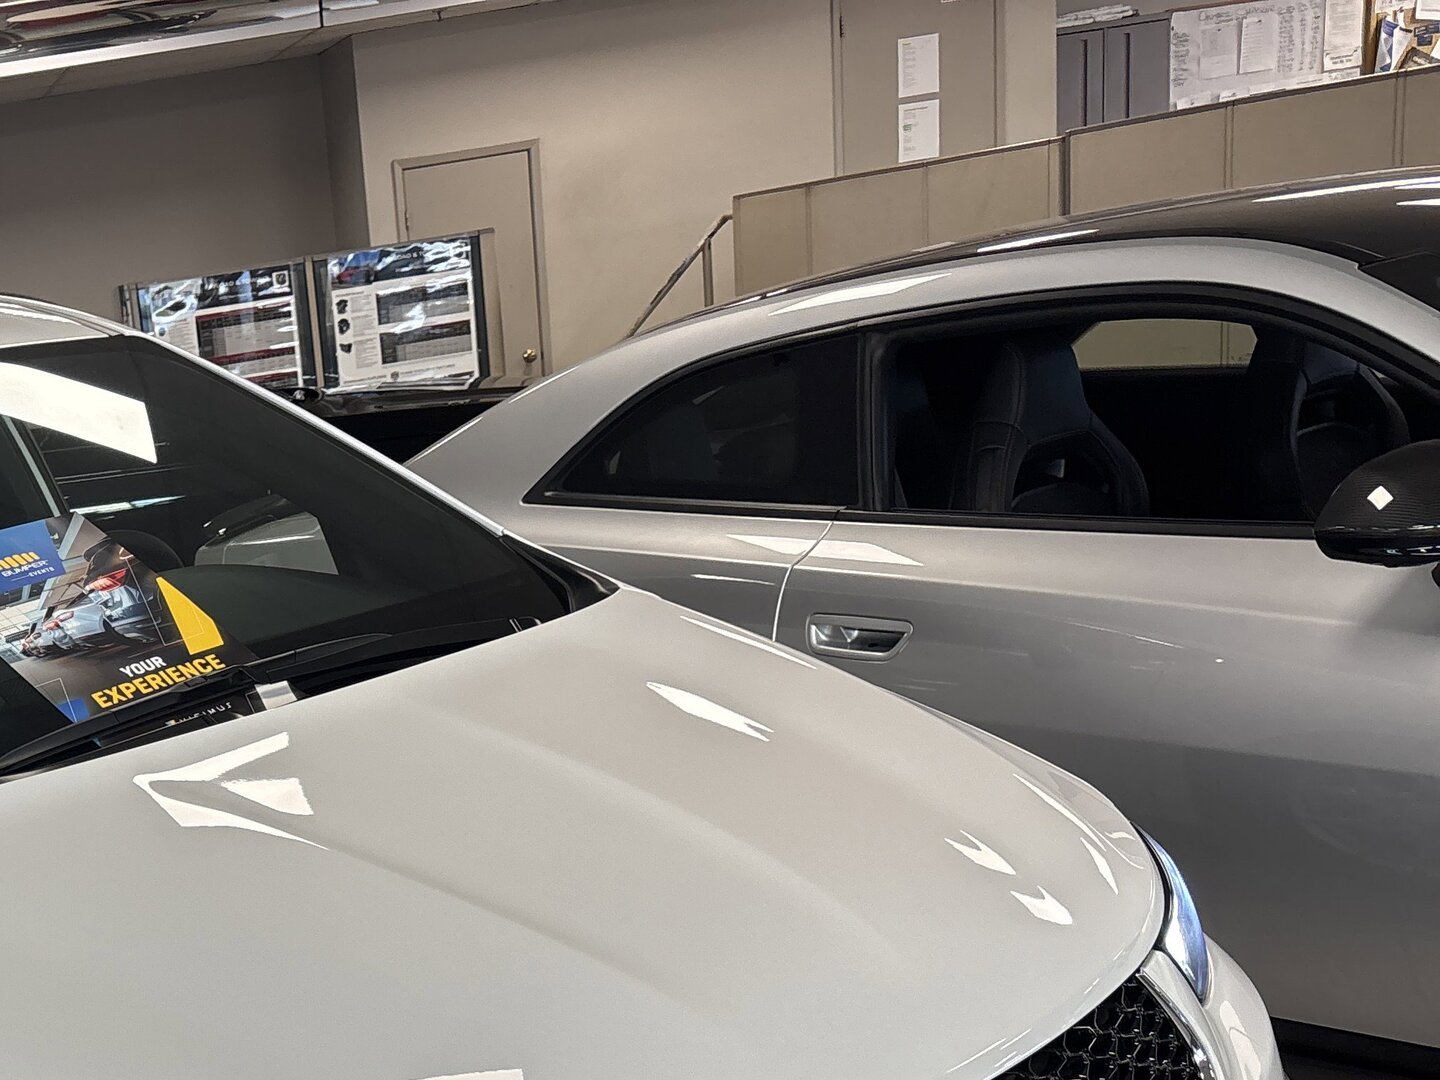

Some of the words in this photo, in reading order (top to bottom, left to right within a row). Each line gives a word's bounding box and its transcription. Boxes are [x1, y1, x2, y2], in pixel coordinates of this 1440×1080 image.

[1, 560, 48, 577] BUMPER
[29, 567, 55, 577] EVENTS
[118, 655, 167, 678] YOUR
[90, 654, 226, 709] EXPERIENCE
